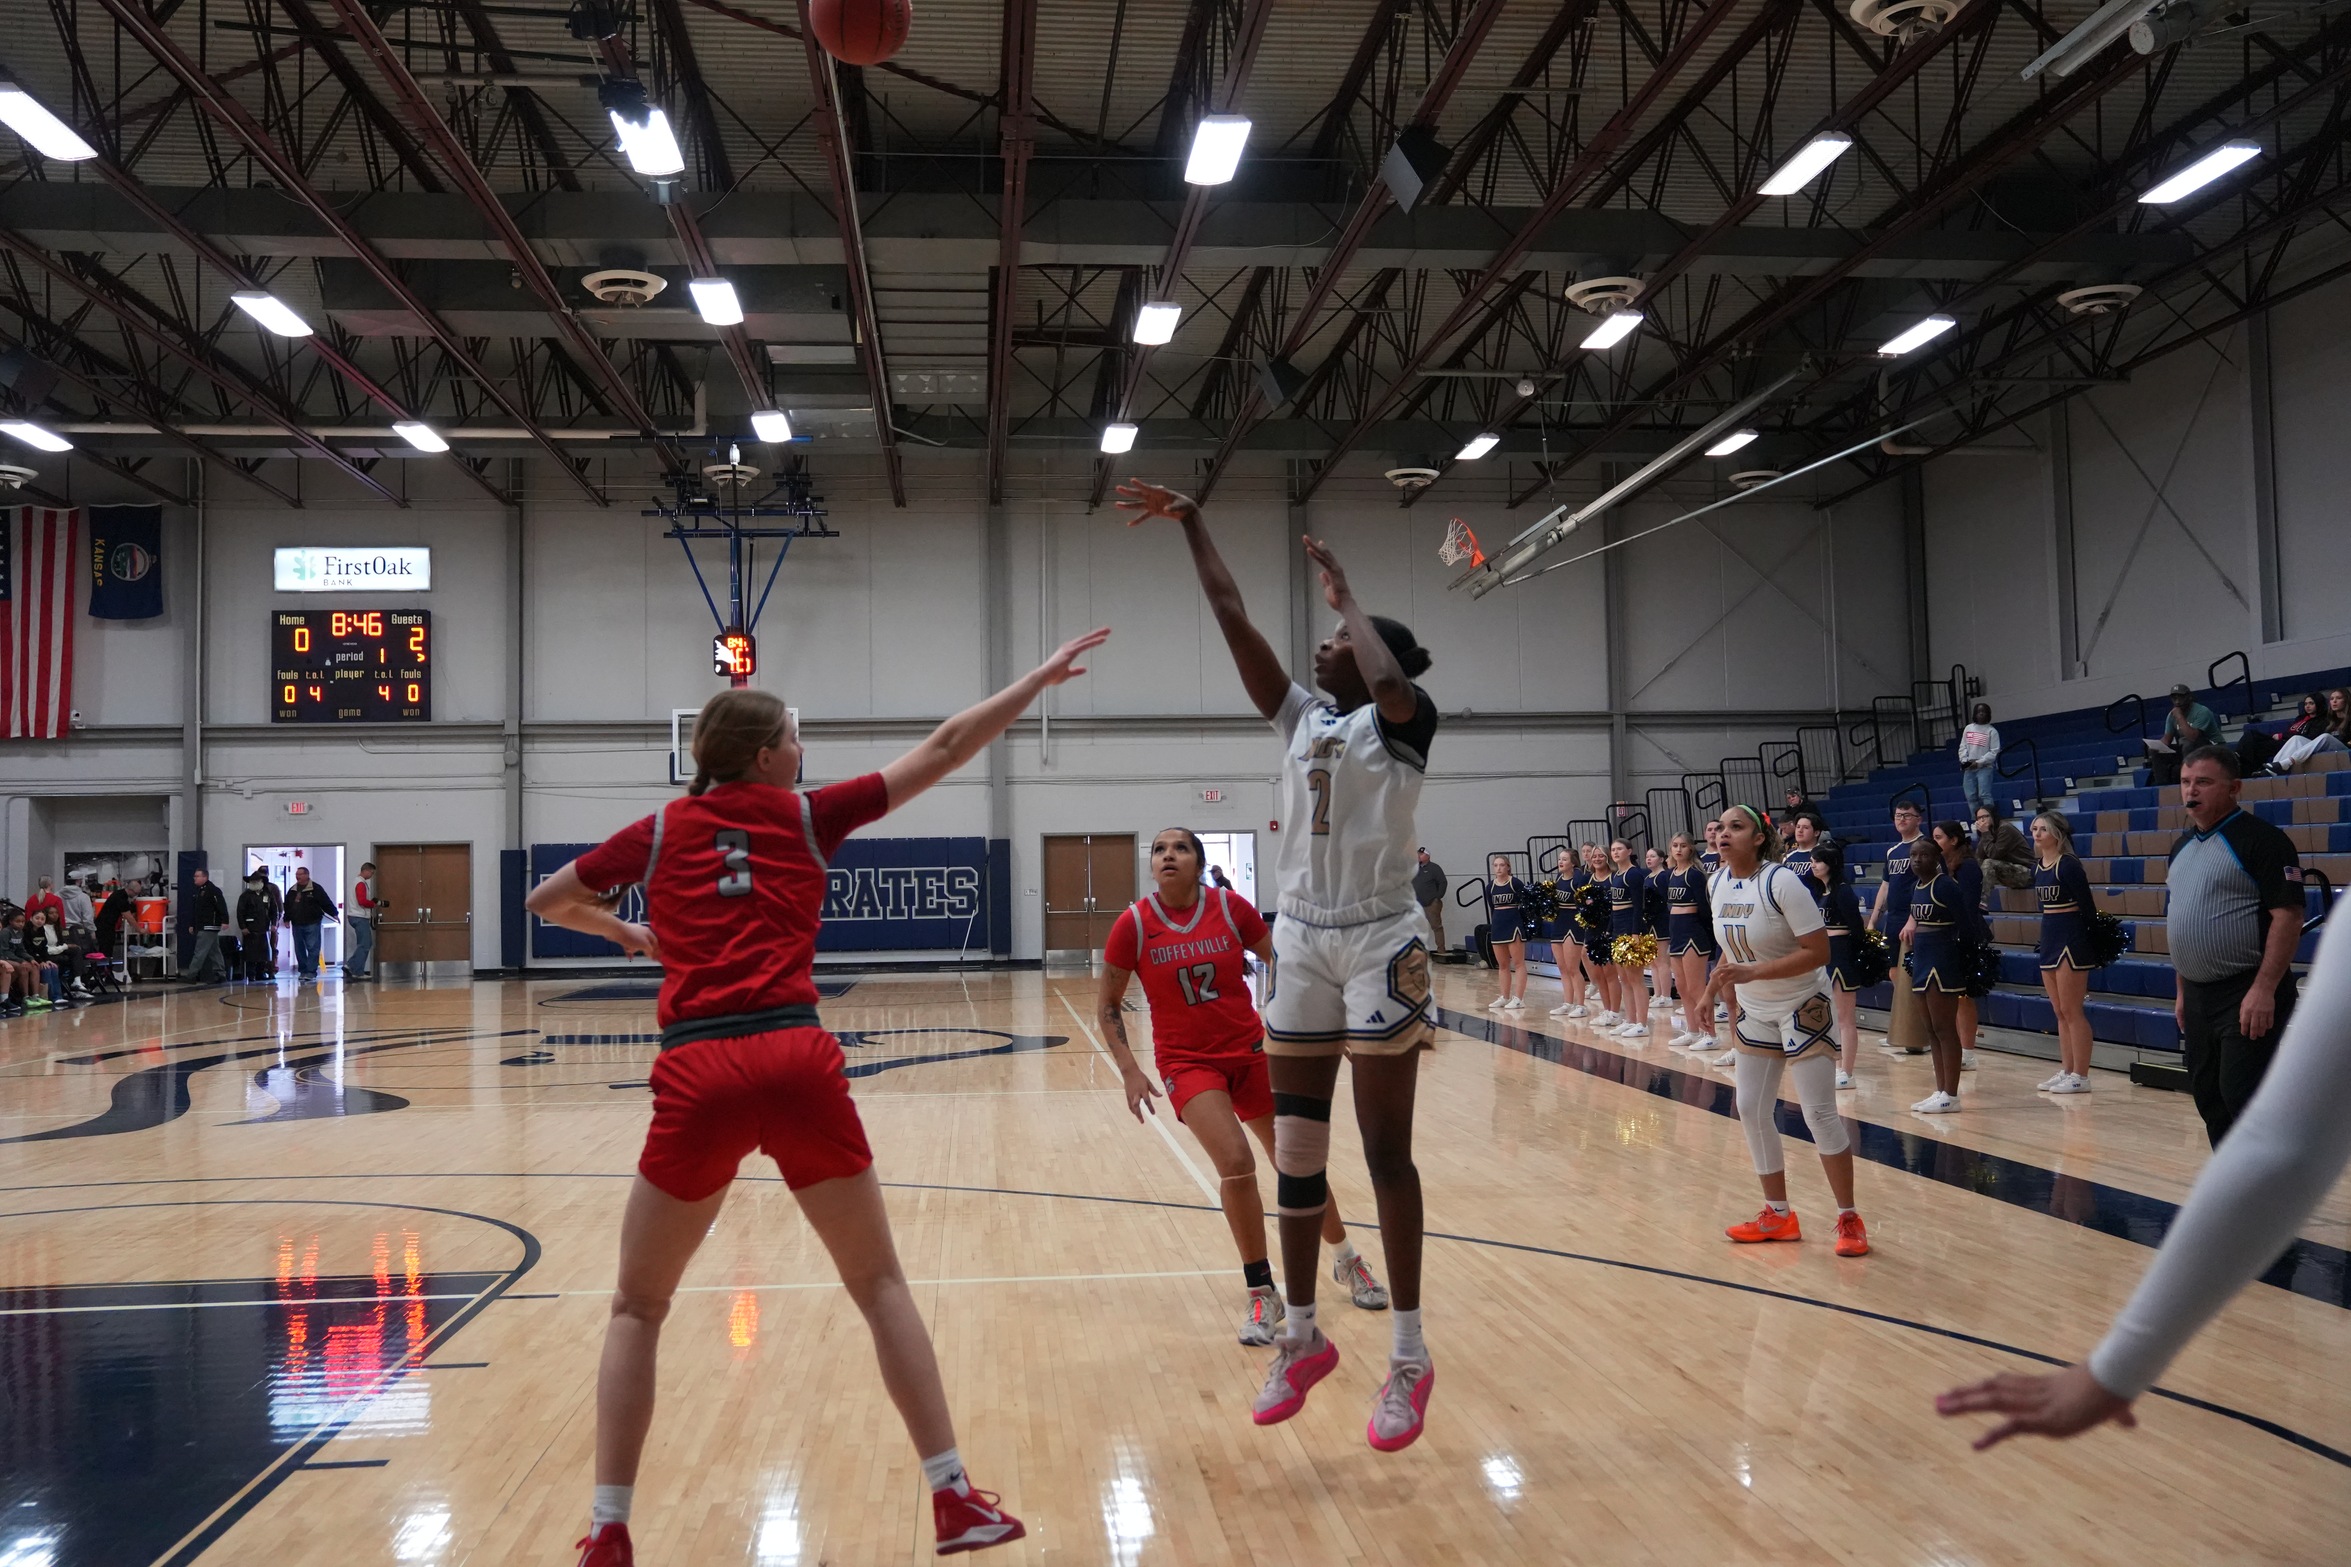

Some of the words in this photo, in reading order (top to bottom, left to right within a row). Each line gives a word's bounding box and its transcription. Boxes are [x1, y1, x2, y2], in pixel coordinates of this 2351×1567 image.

[324, 556, 413, 575] FirstOak
[279, 614, 305, 625] Home
[332, 612, 382, 636] 8:46
[391, 613, 423, 625] Guests
[295, 627, 309, 652] 0
[409, 627, 424, 651] 2
[335, 651, 364, 663] period
[380, 648, 385, 664] 1
[277, 669, 299, 680] fouls
[335, 669, 364, 680] player
[400, 668, 422, 679] fouls
[284, 685, 296, 703] 0
[309, 686, 321, 702] 4
[378, 685, 390, 702] 4
[408, 684, 419, 702] 0
[279, 709, 297, 718] won
[338, 707, 361, 719] game
[402, 707, 420, 717] won
[1205, 791, 1219, 801] EXIT
[1307, 769, 1331, 835] 2
[291, 802, 306, 813] EXIT
[715, 829, 752, 897] 3
[820, 866, 979, 921] RATES
[2035, 885, 2060, 902] NDY
[1718, 903, 1755, 919] INDY
[1149, 936, 1230, 965] COFFEYVILLE
[1723, 924, 1757, 963] 11
[1177, 961, 1221, 1007] 12
